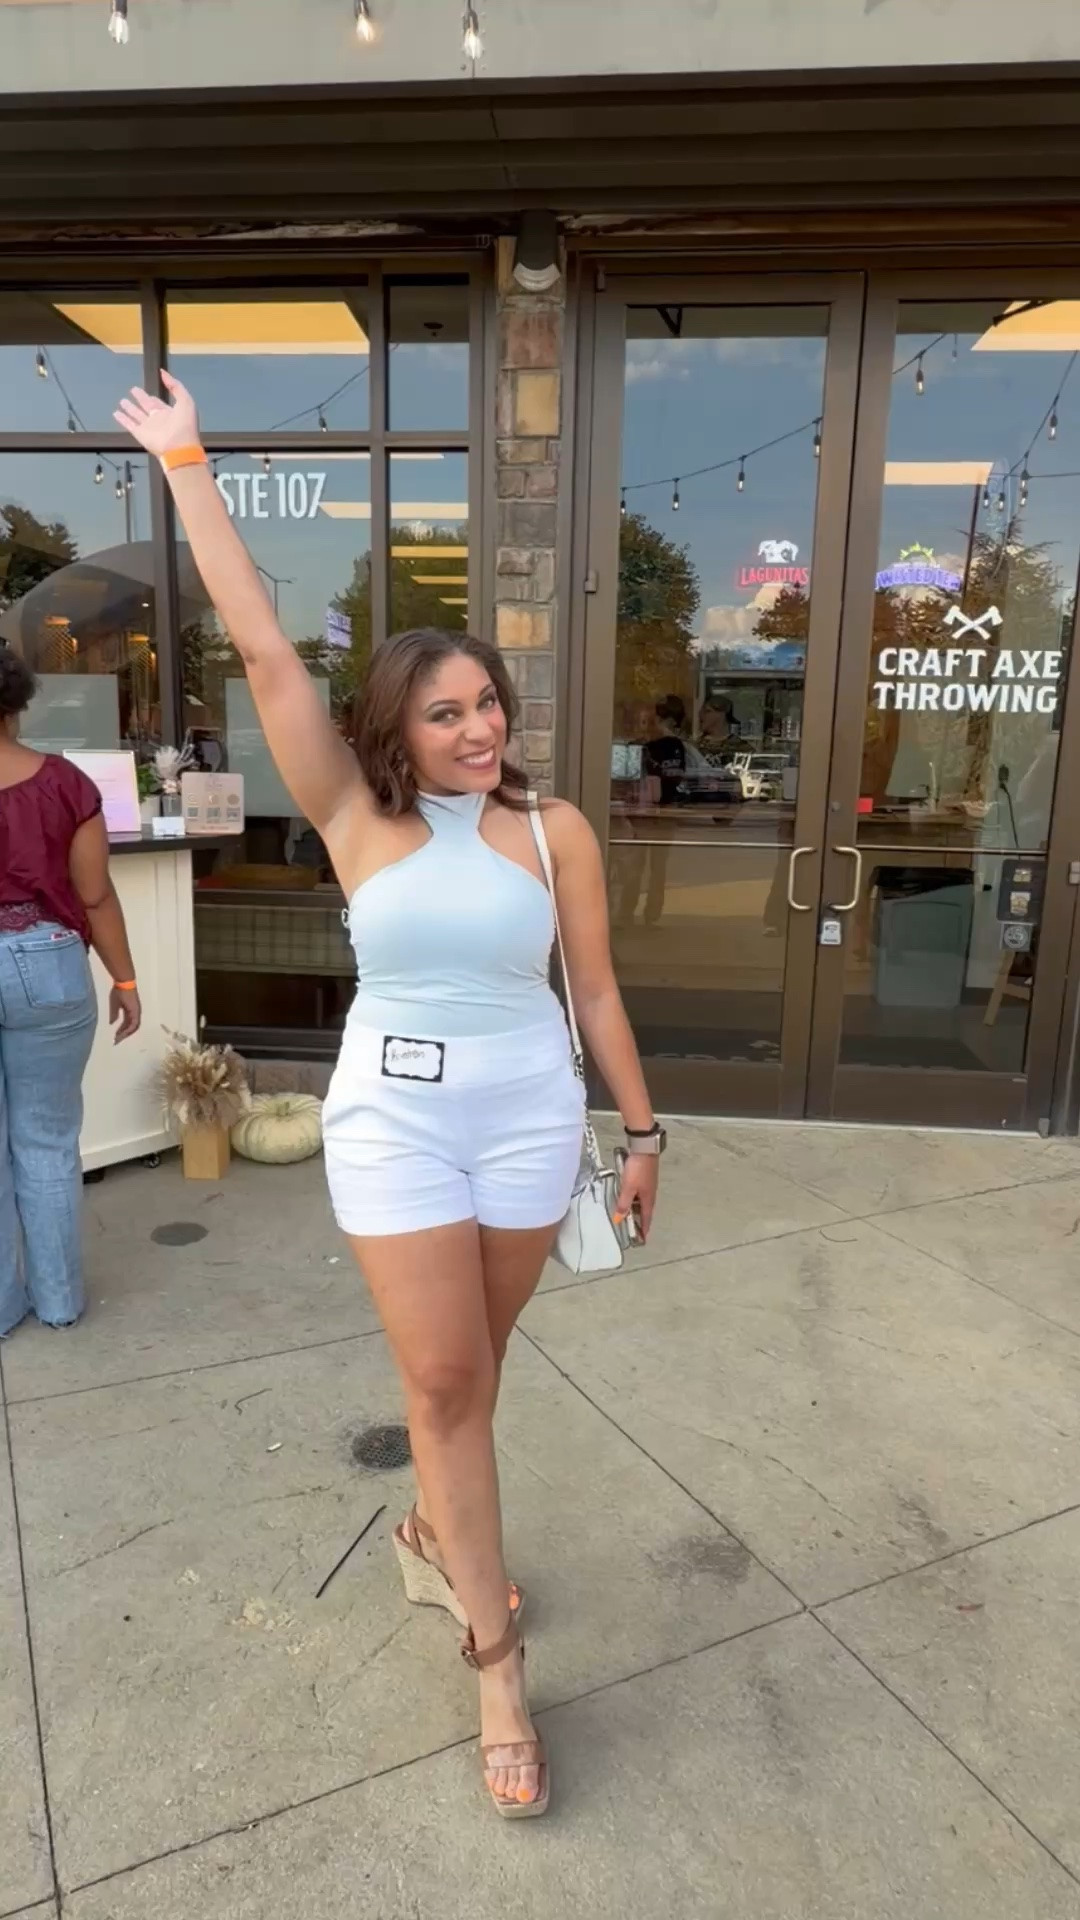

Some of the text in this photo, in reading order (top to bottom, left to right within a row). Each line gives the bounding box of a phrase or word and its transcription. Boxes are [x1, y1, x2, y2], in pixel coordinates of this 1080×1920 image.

[216, 472, 327, 518] STE 107
[741, 567, 809, 585] LAGUNITAS
[878, 648, 1063, 679] CRAFT AXE
[873, 681, 1058, 713] THROWING
